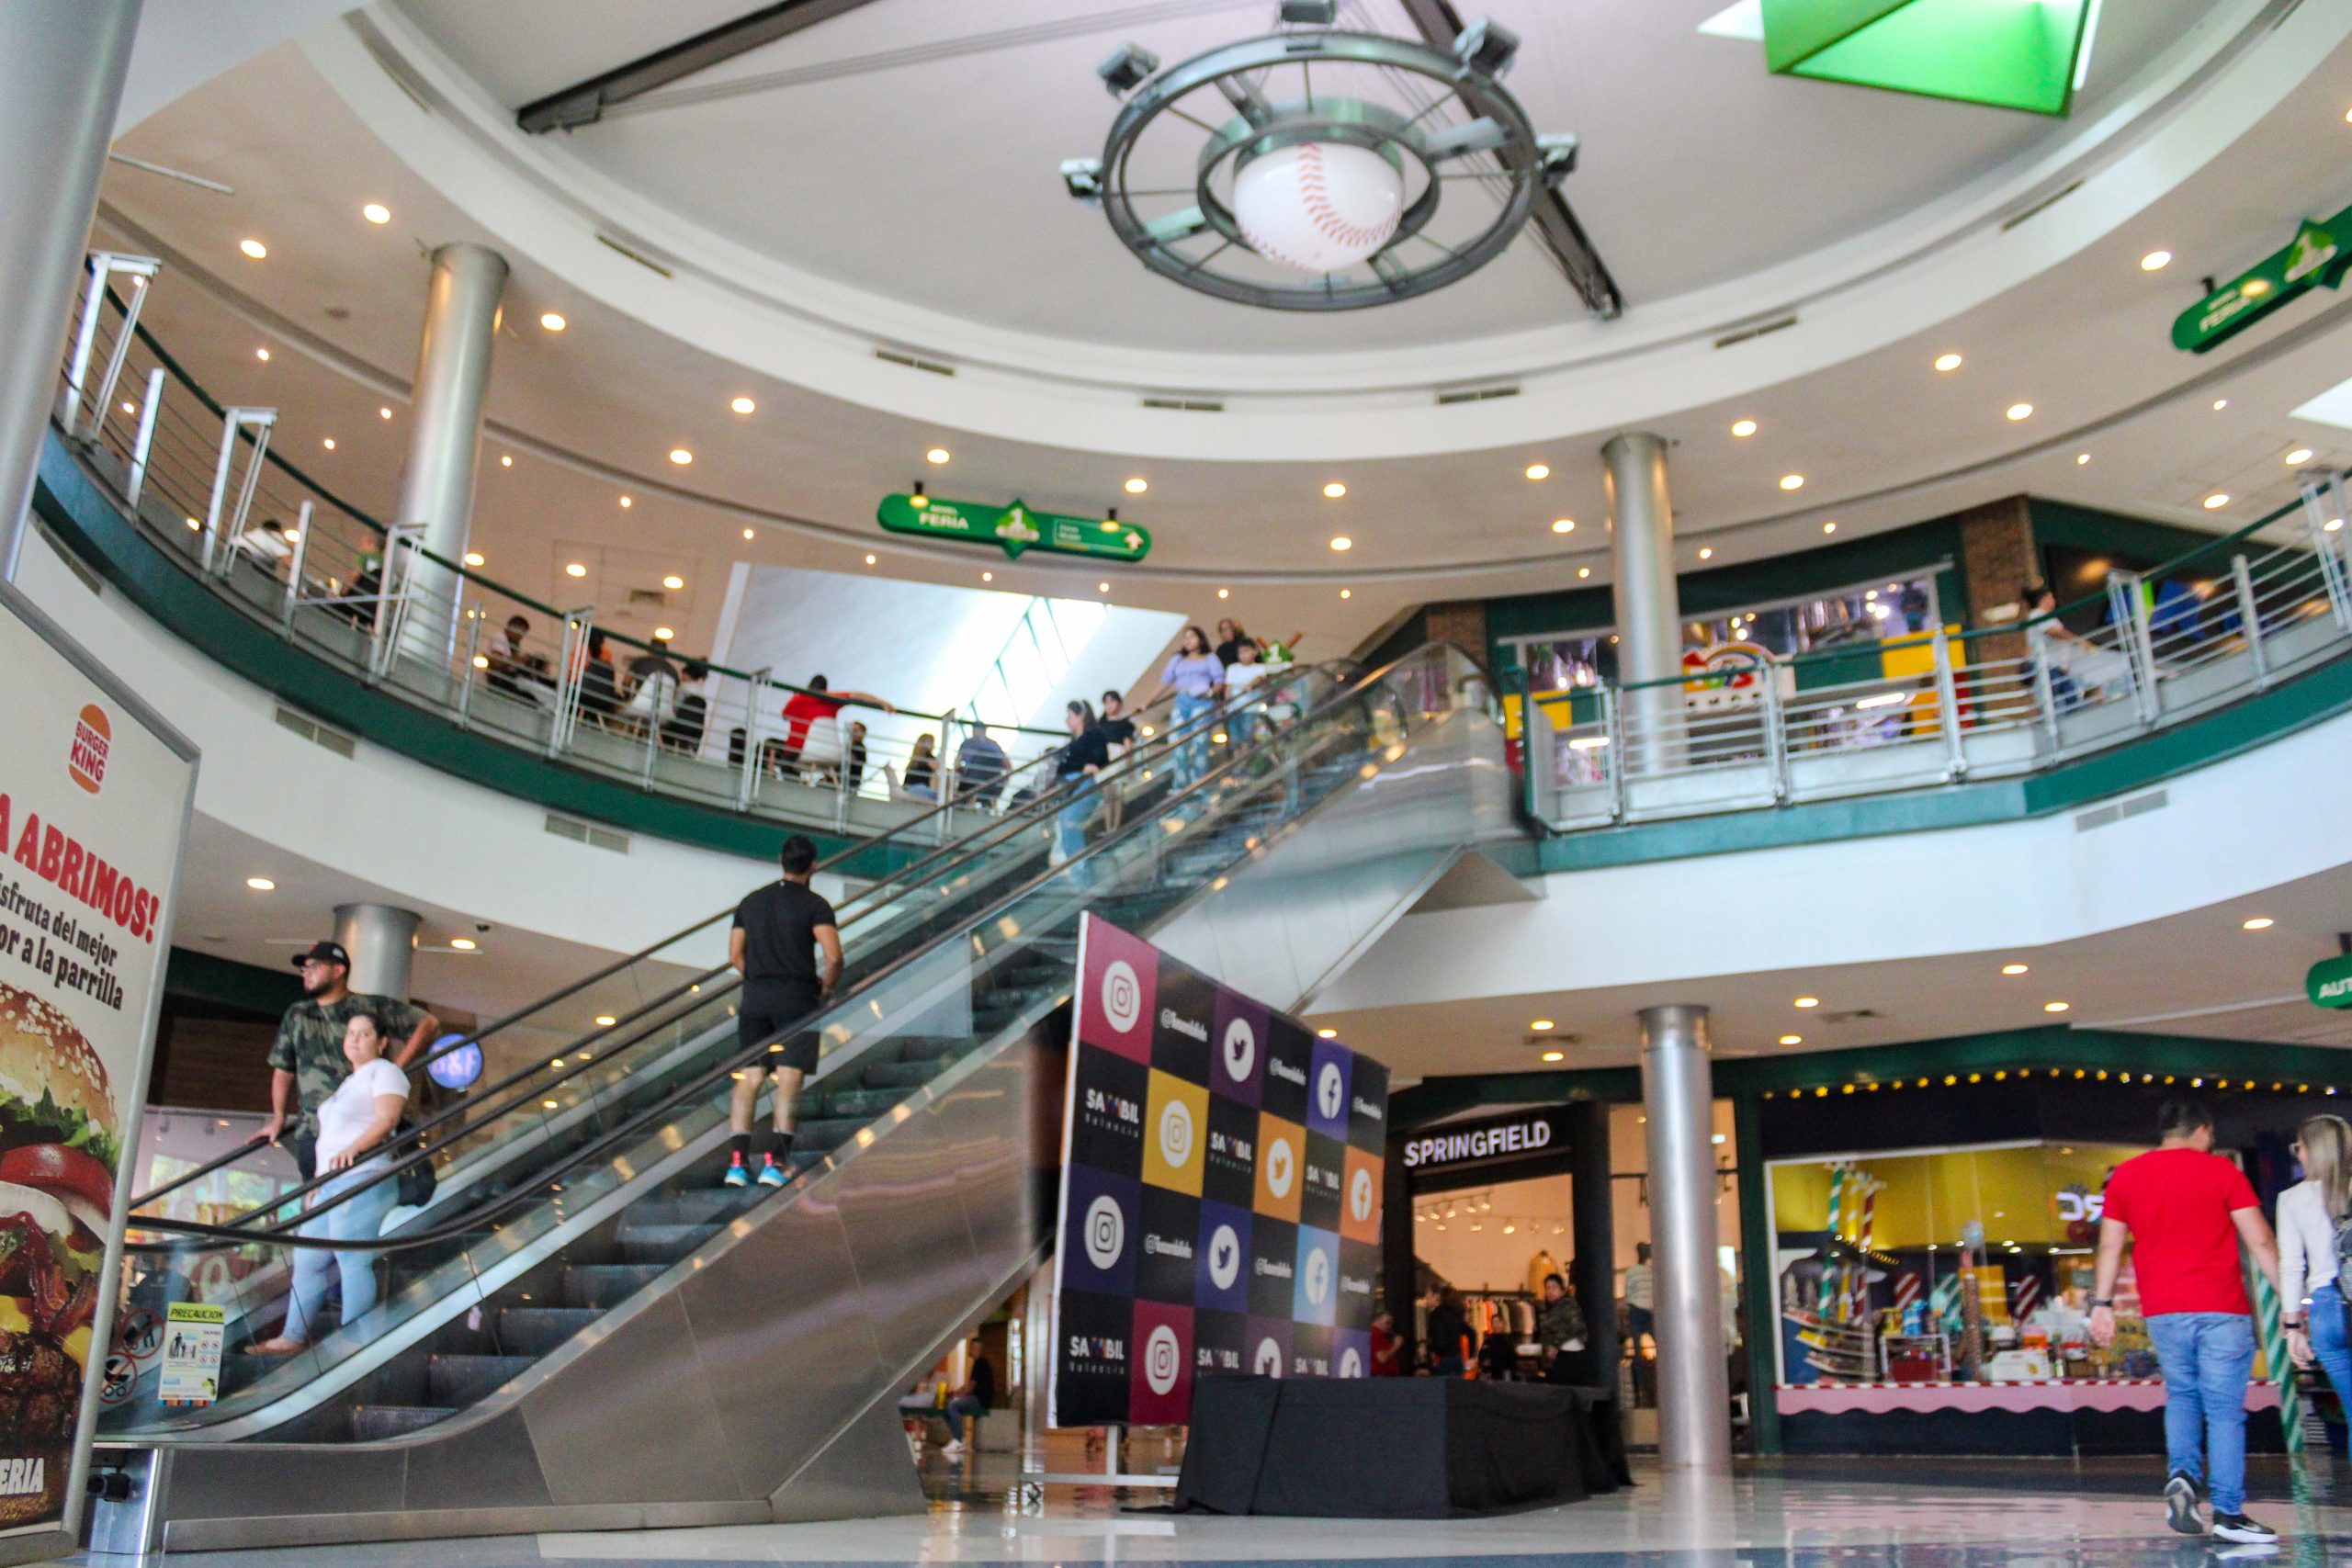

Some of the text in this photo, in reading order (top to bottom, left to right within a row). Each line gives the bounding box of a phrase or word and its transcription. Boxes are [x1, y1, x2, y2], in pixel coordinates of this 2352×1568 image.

[919, 512, 968, 530] FERIA
[71, 739, 106, 783] KING
[75, 720, 109, 761] BURGER
[14, 812, 160, 945] ABRIMOS!
[0, 873, 119, 967] sfruta del mejor
[21, 937, 34, 964] a
[35, 936, 54, 976] la
[53, 955, 123, 1011] parrilla
[1403, 1121, 1551, 1168] SPRINGFIELD
[1306, 1165, 1340, 1190] SABIL
[1197, 1348, 1240, 1370] SABIL
[1295, 1358, 1329, 1377] SABIL
